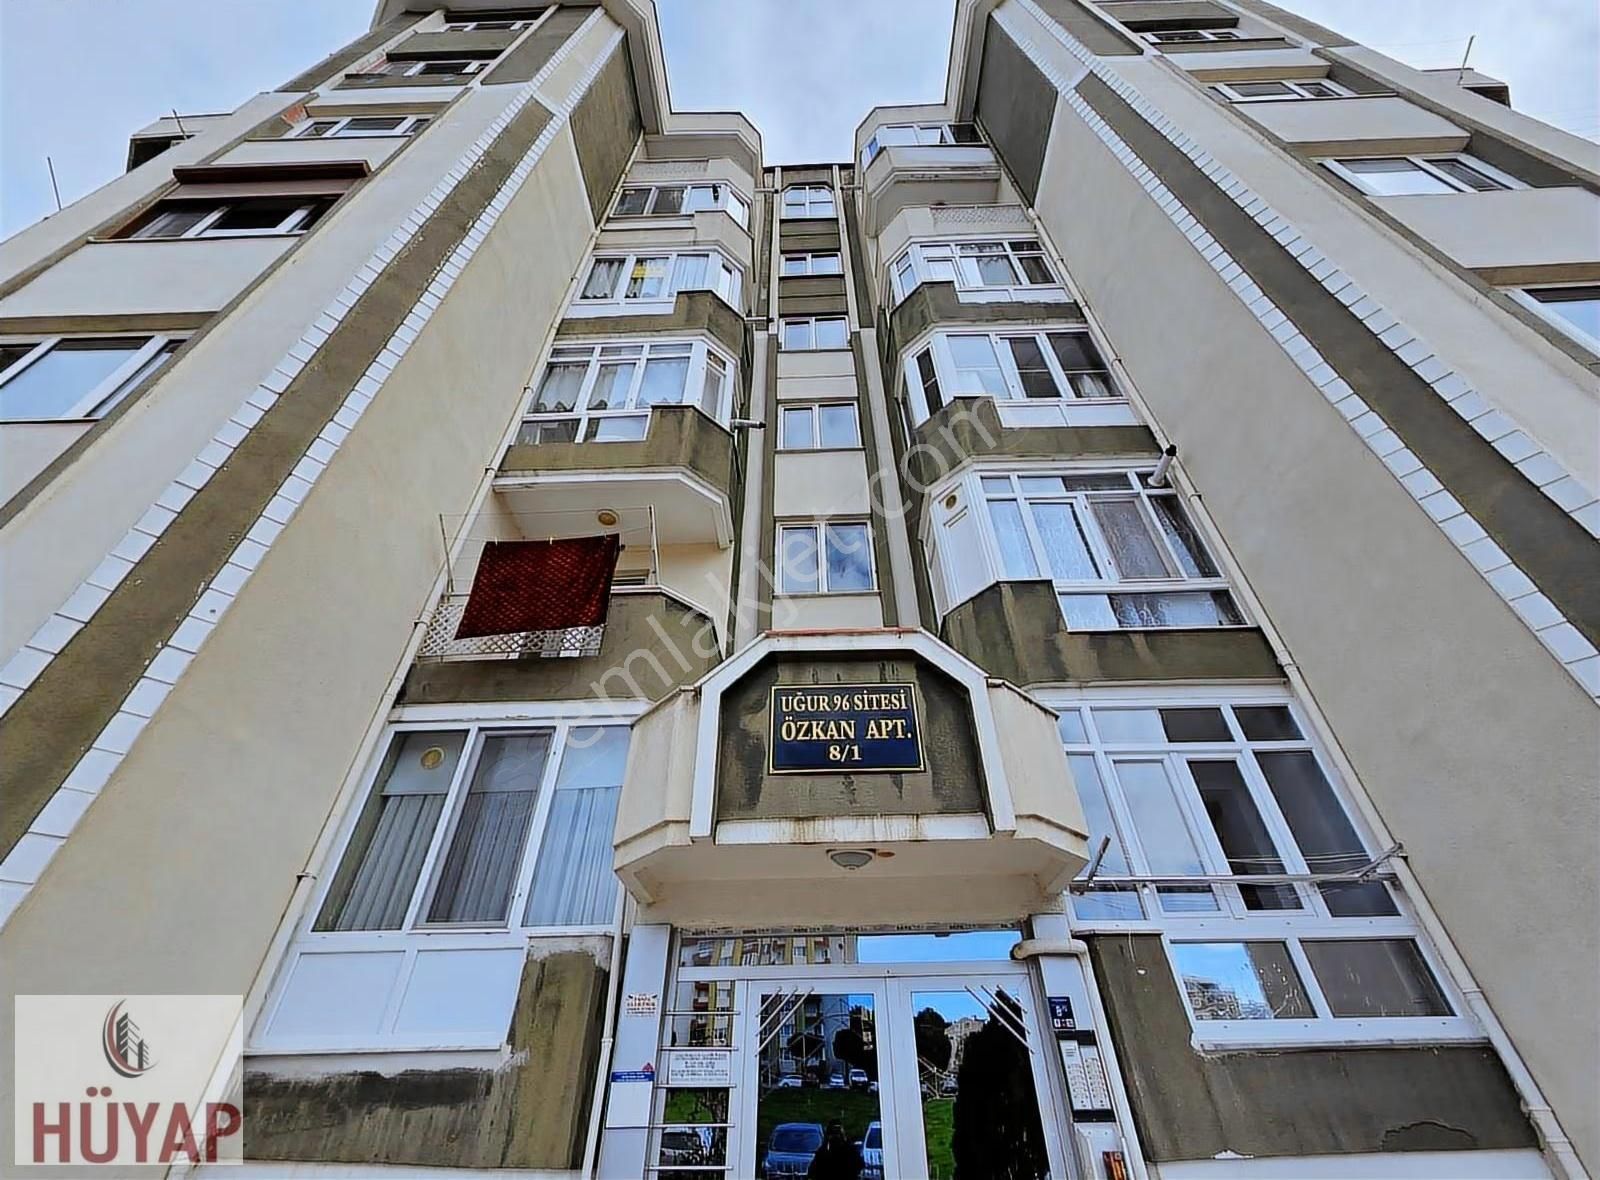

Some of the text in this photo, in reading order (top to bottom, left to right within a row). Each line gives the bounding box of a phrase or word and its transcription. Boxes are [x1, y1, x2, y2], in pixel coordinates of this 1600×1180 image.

[781, 689, 908, 712] UĞUR 96 SİTESİ
[782, 717, 912, 741] ÖZKAN APT.
[828, 744, 862, 762] 8/1
